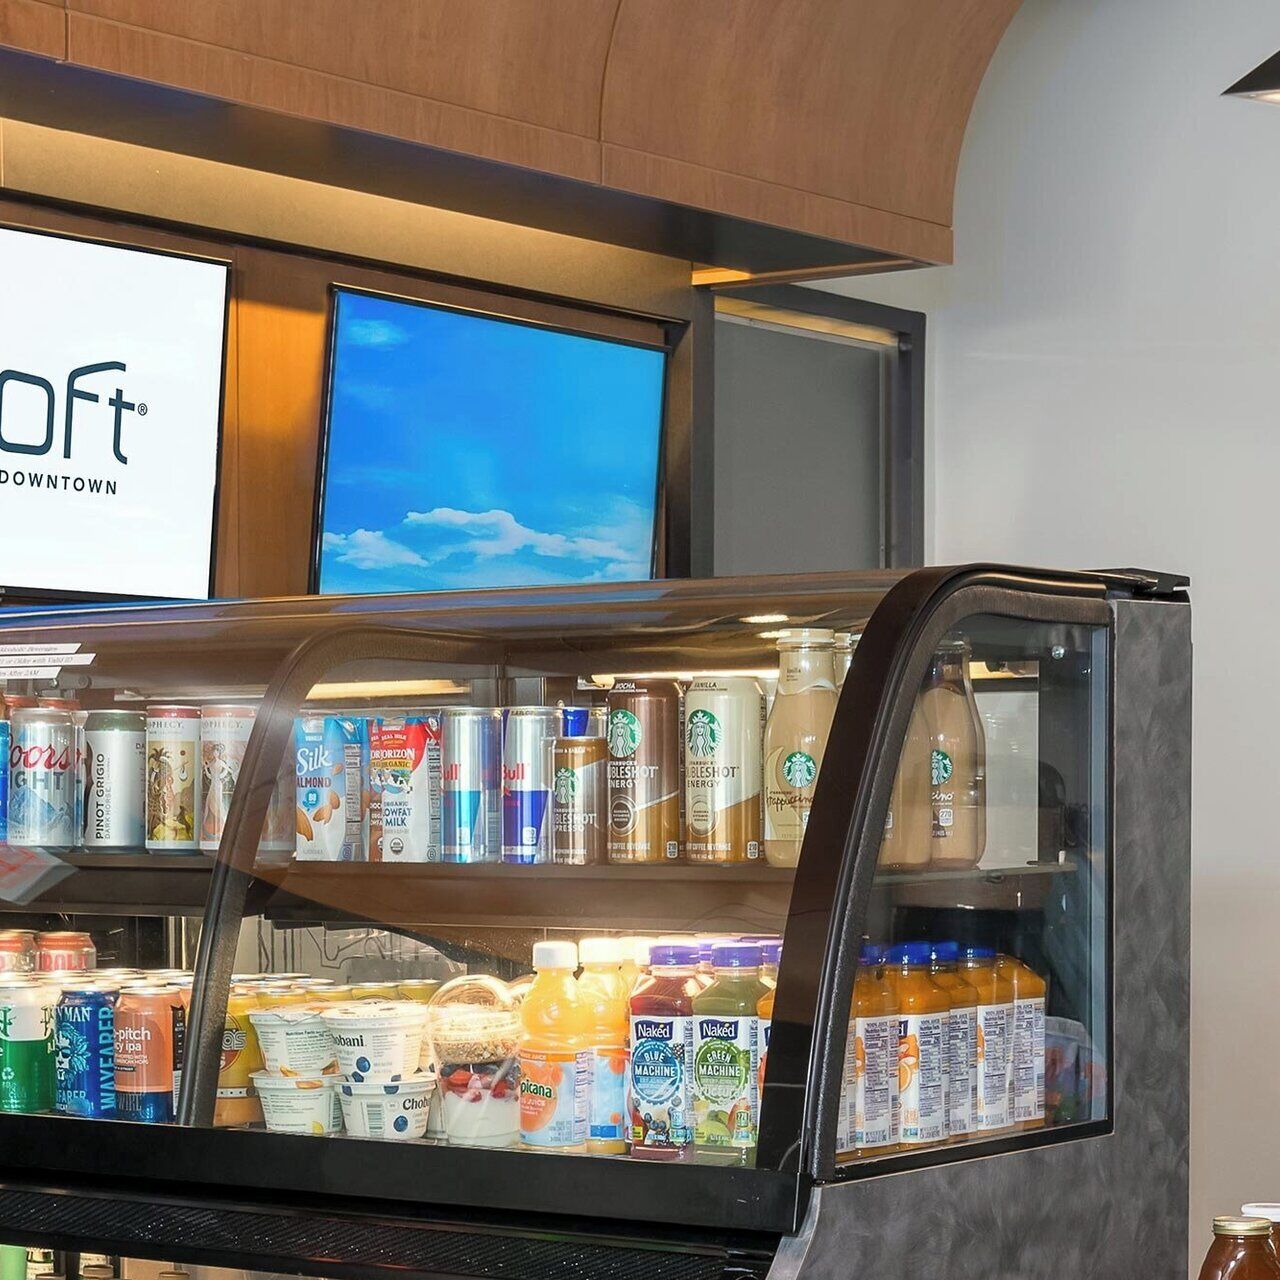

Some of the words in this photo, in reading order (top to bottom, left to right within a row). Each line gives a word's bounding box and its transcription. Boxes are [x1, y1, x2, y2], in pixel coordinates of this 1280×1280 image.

[297, 745, 333, 775] Silk
[95, 753, 105, 798] GRIGIO
[95, 802, 105, 839] PINOT
[638, 1023, 670, 1038] Naked
[703, 1022, 735, 1037] Naked
[126, 1043, 142, 1053] ipa
[644, 1051, 666, 1062] BLUE
[707, 1050, 732, 1062] GREEN
[635, 1065, 675, 1077] MACHINE
[699, 1064, 741, 1077] MACHINE
